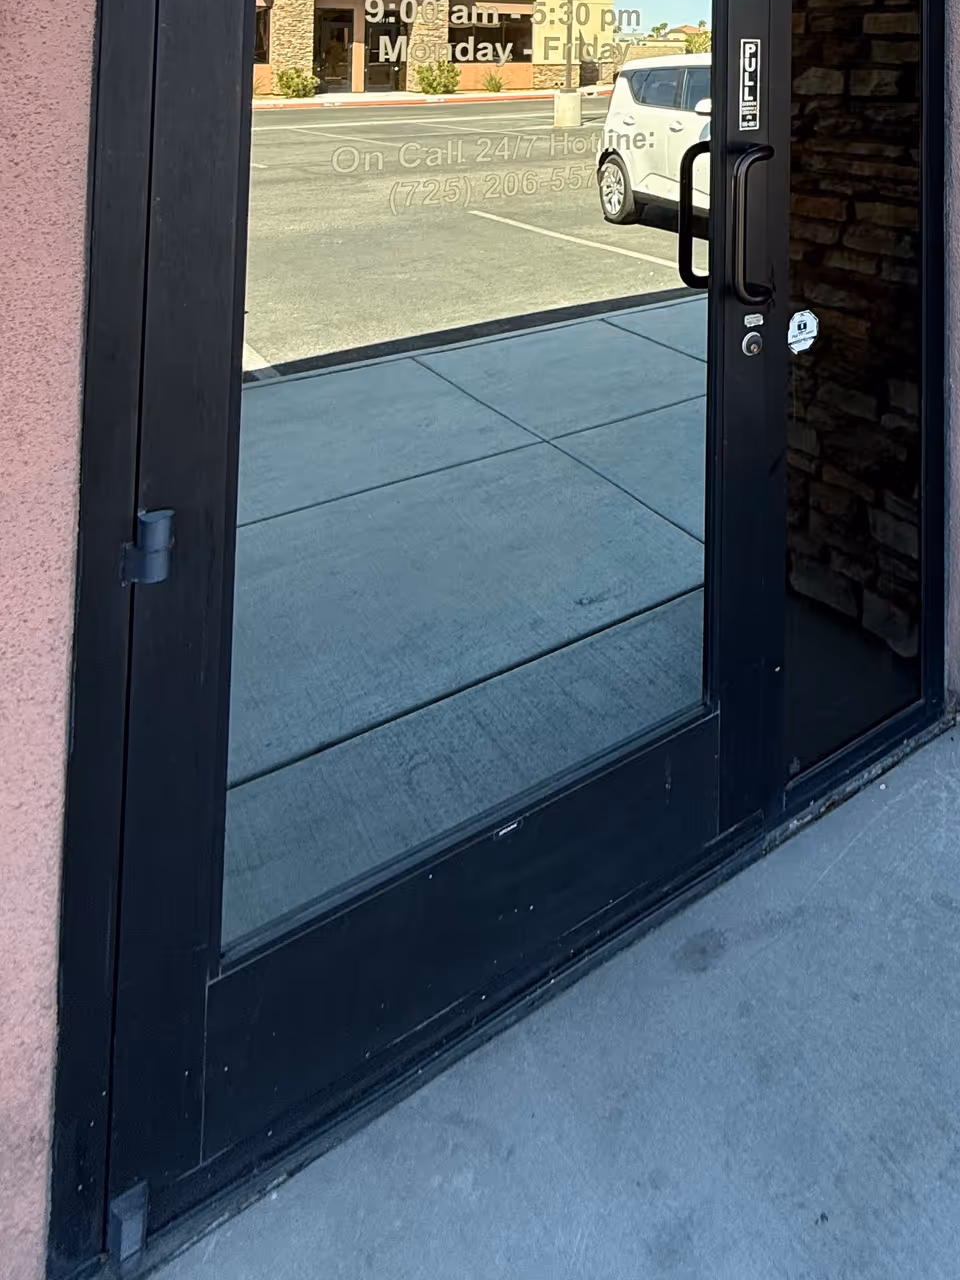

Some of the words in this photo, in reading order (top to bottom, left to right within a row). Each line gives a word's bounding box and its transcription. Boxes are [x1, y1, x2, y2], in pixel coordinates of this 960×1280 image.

[450, 3, 501, 26] am
[531, 1, 591, 26] 5:30
[600, 6, 641, 32] pm
[378, 35, 514, 67] Monday
[543, 35, 631, 65] Friday
[743, 43, 756, 101] PULL
[330, 145, 384, 174] On
[398, 138, 464, 168] Call
[475, 133, 538, 163] 24/7
[550, 128, 655, 157] Hotline:
[389, 175, 472, 216] (725)
